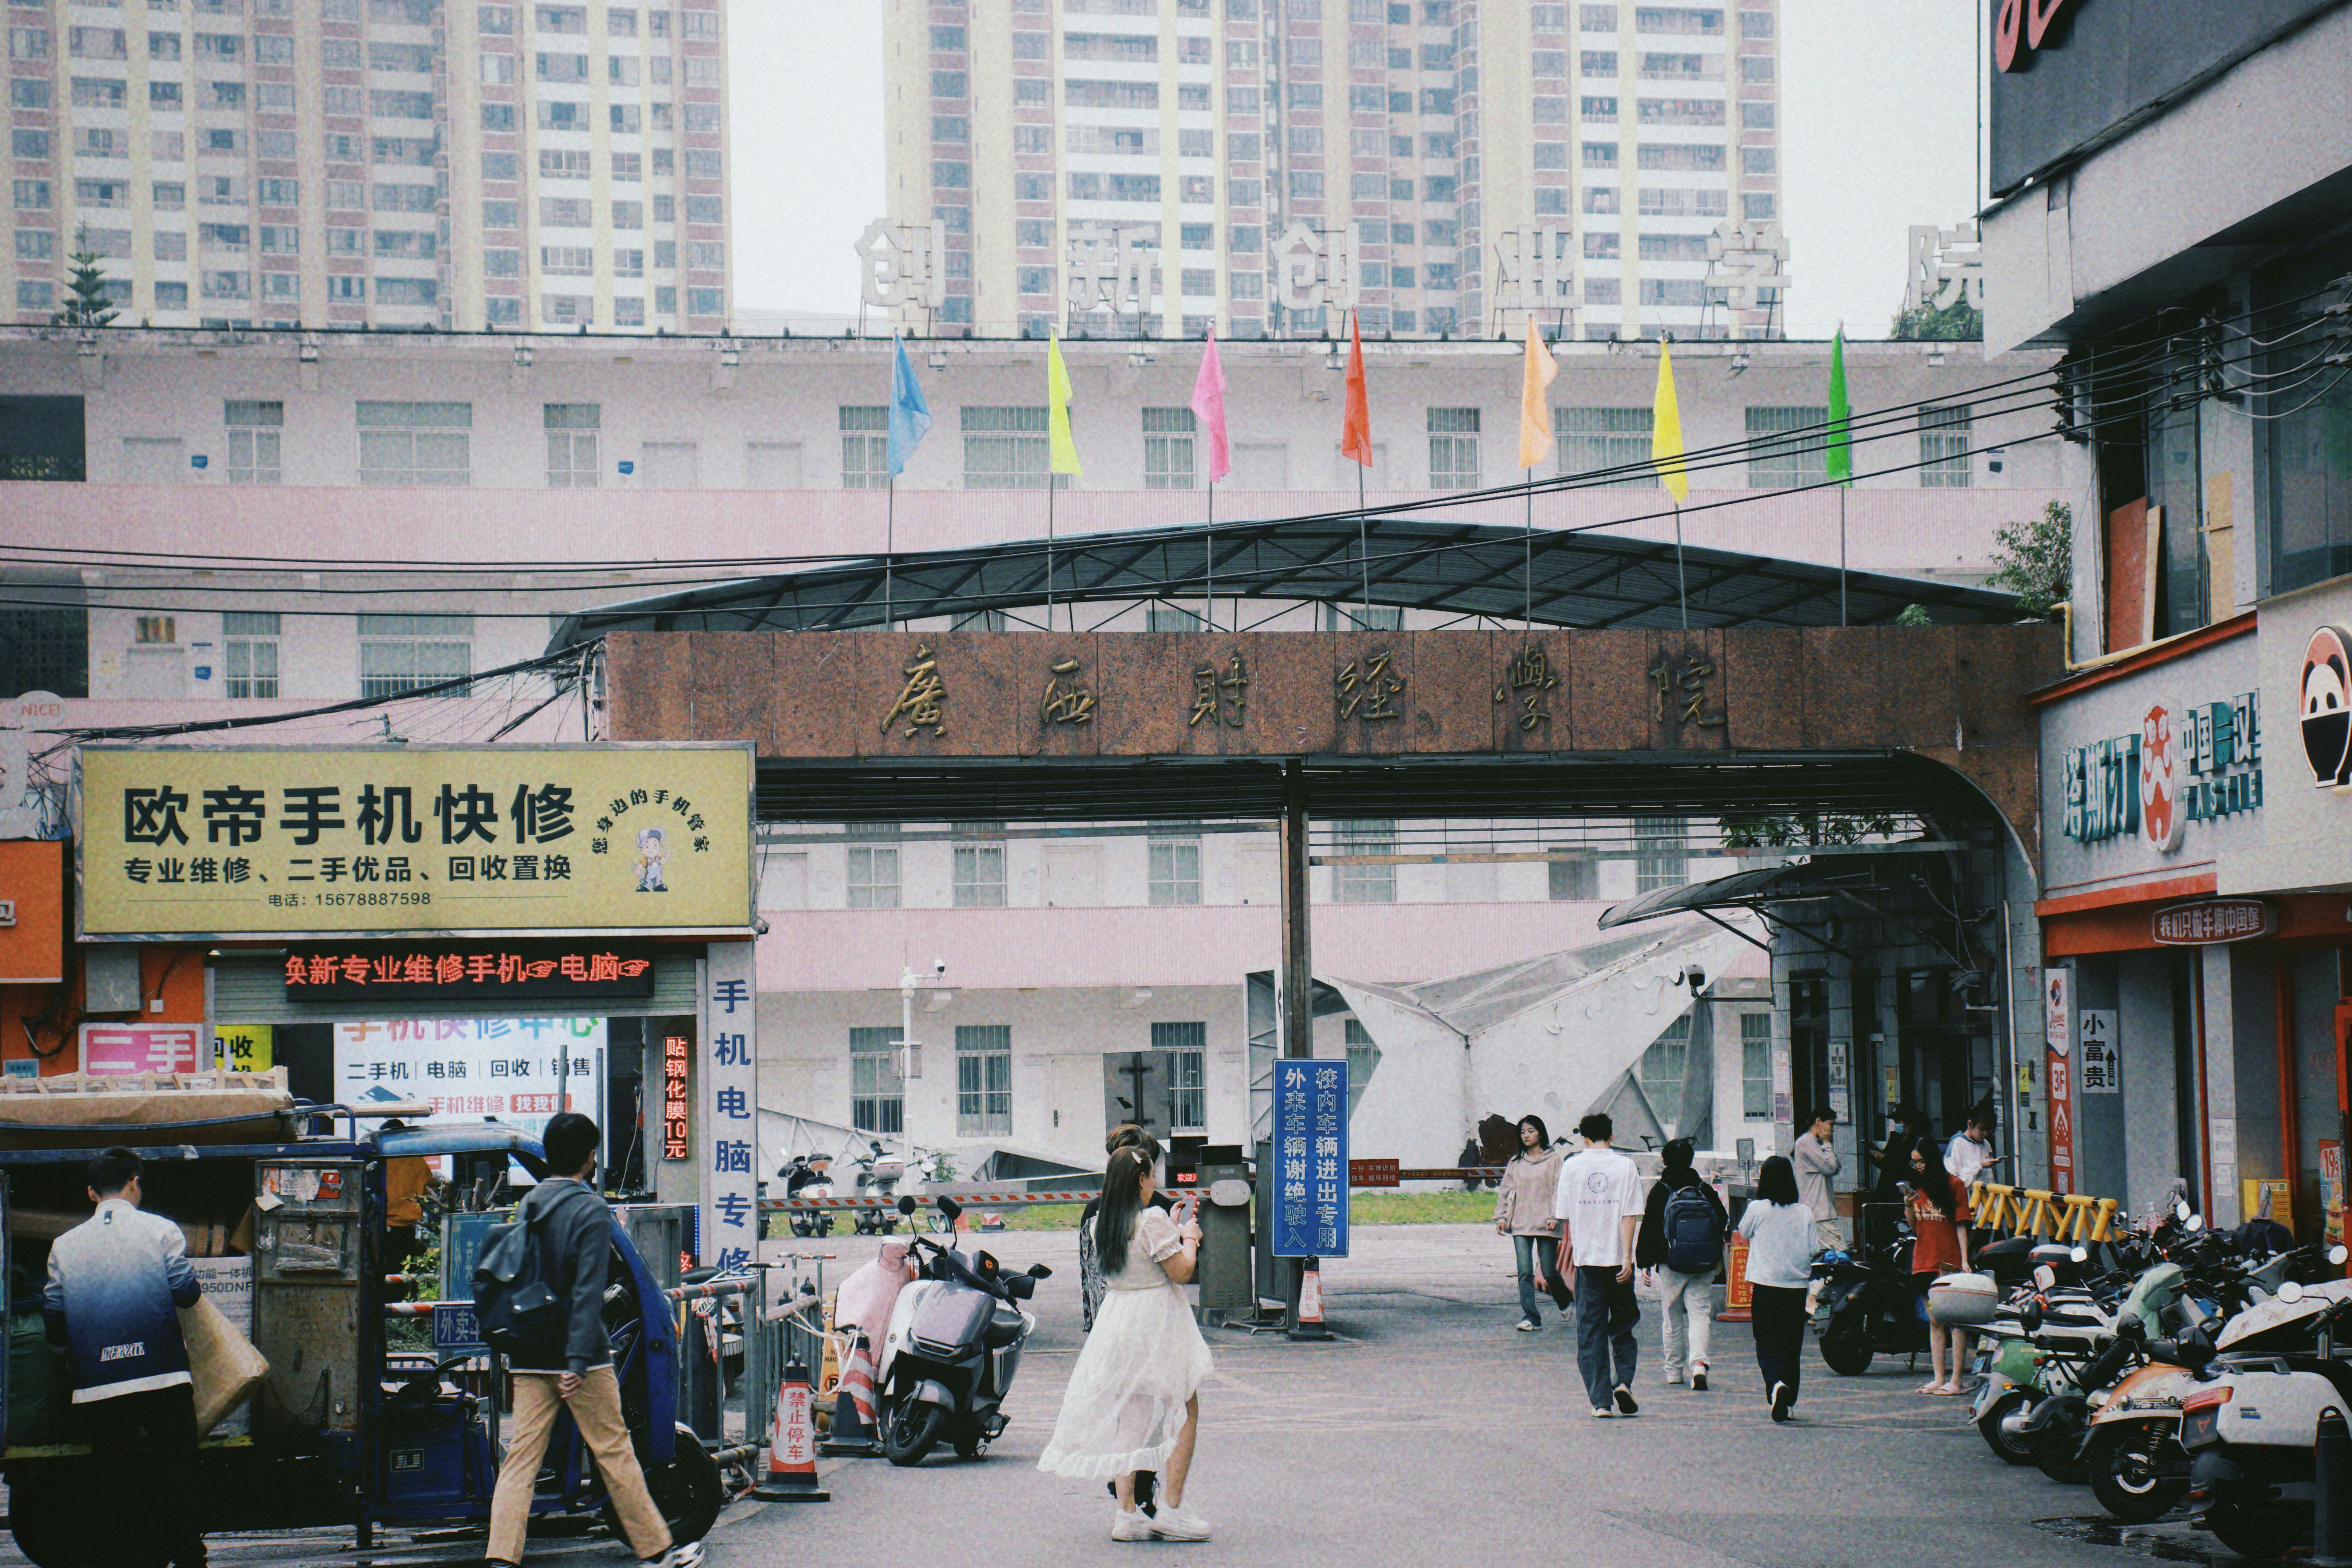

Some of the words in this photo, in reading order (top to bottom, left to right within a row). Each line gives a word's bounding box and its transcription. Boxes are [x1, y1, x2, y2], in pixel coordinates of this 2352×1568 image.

[853, 216, 1984, 313] 创新创业学院
[22, 703, 61, 716] NICE!
[2062, 736, 2132, 837] 塔斯汀
[124, 784, 576, 846] 欧帝手机快修
[592, 789, 709, 855] 您身边的手机管家
[124, 854, 572, 884] 专业维修、二手优品、回收置换
[315, 892, 431, 906] 15678887598
[285, 953, 525, 985] 焕新专业维修手机
[560, 952, 619, 982] 电脑
[89, 1033, 194, 1073] 二手
[347, 1061, 408, 1080] 二手机
[427, 1059, 466, 1079] 电脑
[491, 1058, 530, 1077] 回收
[2083, 1014, 2106, 1088] 小富贵
[427, 1095, 504, 1114] 手机维修
[664, 1038, 686, 1158] 贴钢化膜10元
[2054, 1070, 2065, 1092] 3F
[712, 978, 752, 1275] 手机电脑专修
[1284, 1068, 1307, 1248] 外来车辆谢绝驶入
[1316, 1068, 1338, 1249] 校内车辆进出专用
[1304, 1275, 1315, 1312] 禁止停车
[100, 1341, 145, 1362] ALTERNATE
[787, 1392, 806, 1461] 禁止停车
